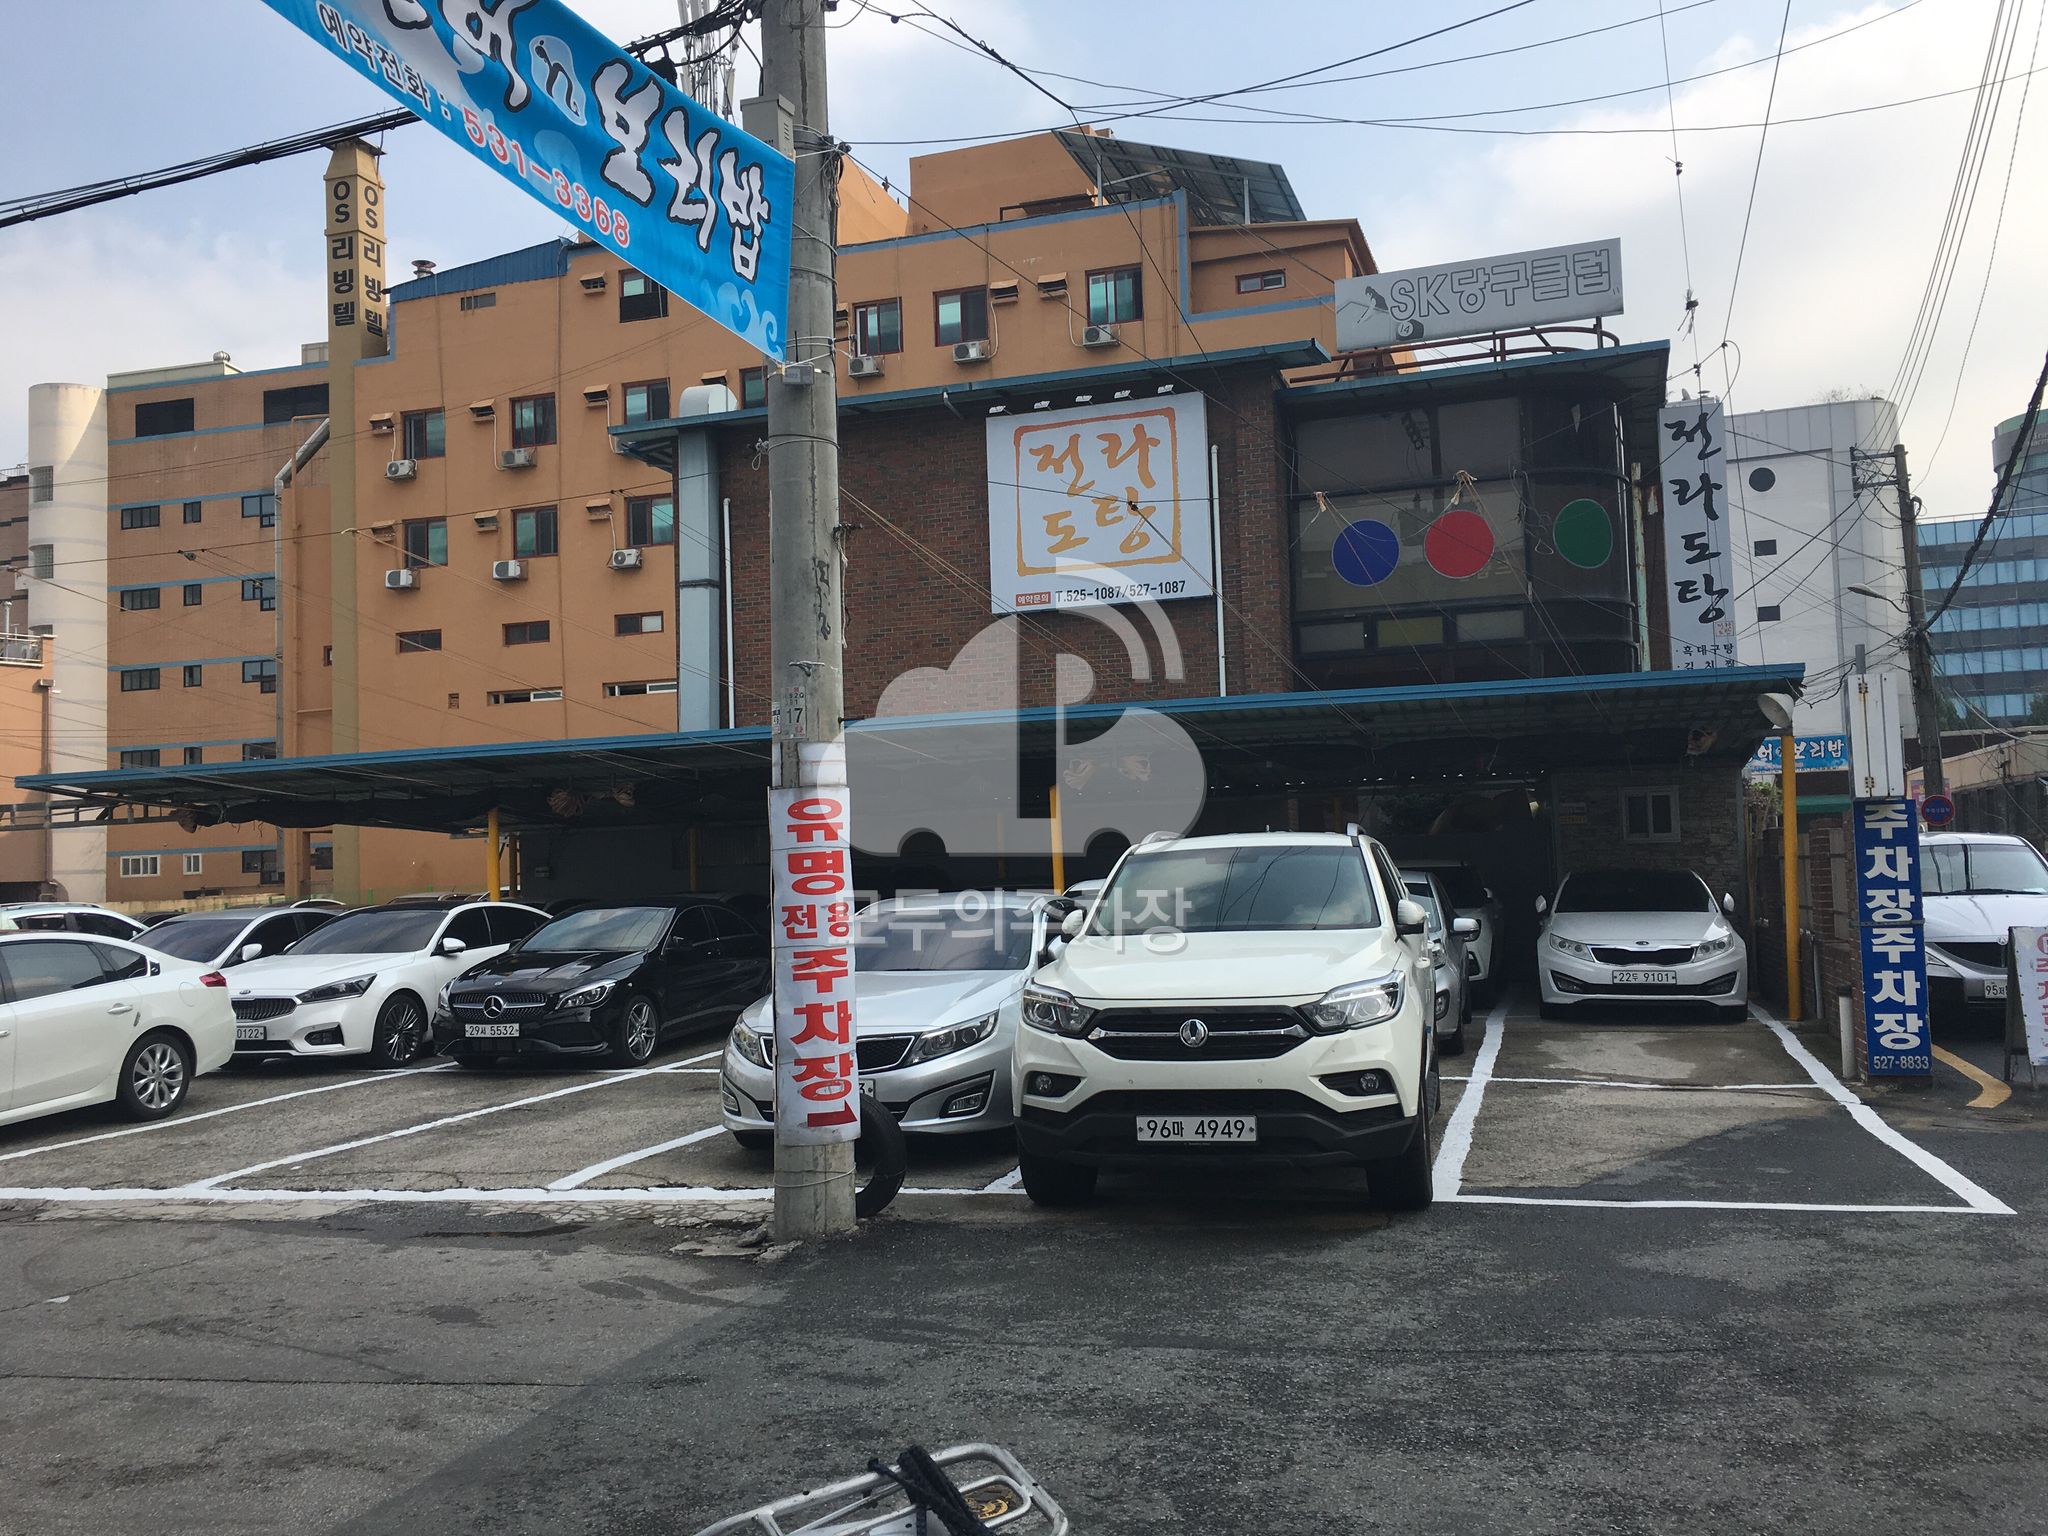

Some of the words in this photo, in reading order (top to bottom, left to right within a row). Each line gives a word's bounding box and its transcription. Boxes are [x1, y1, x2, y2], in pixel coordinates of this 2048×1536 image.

[315, 3, 431, 111] 예약전화
[462, 103, 631, 248] 531-3368
[592, 57, 771, 284] 보리밥
[333, 180, 351, 224] OS
[364, 185, 379, 229] OS
[331, 236, 355, 327] 리빙텔
[363, 237, 383, 338] 리빙텔
[1043, 487, 1157, 553] 도탕
[787, 708, 803, 723] 17
[787, 797, 845, 895] 유명
[782, 901, 850, 940] 전용
[1643, 972, 1669, 982] 9101
[490, 1024, 515, 1036] 5532
[1873, 1055, 1929, 1070] 527-8833
[1147, 1119, 1185, 1138] 96마
[1194, 1119, 1245, 1138] 4949
